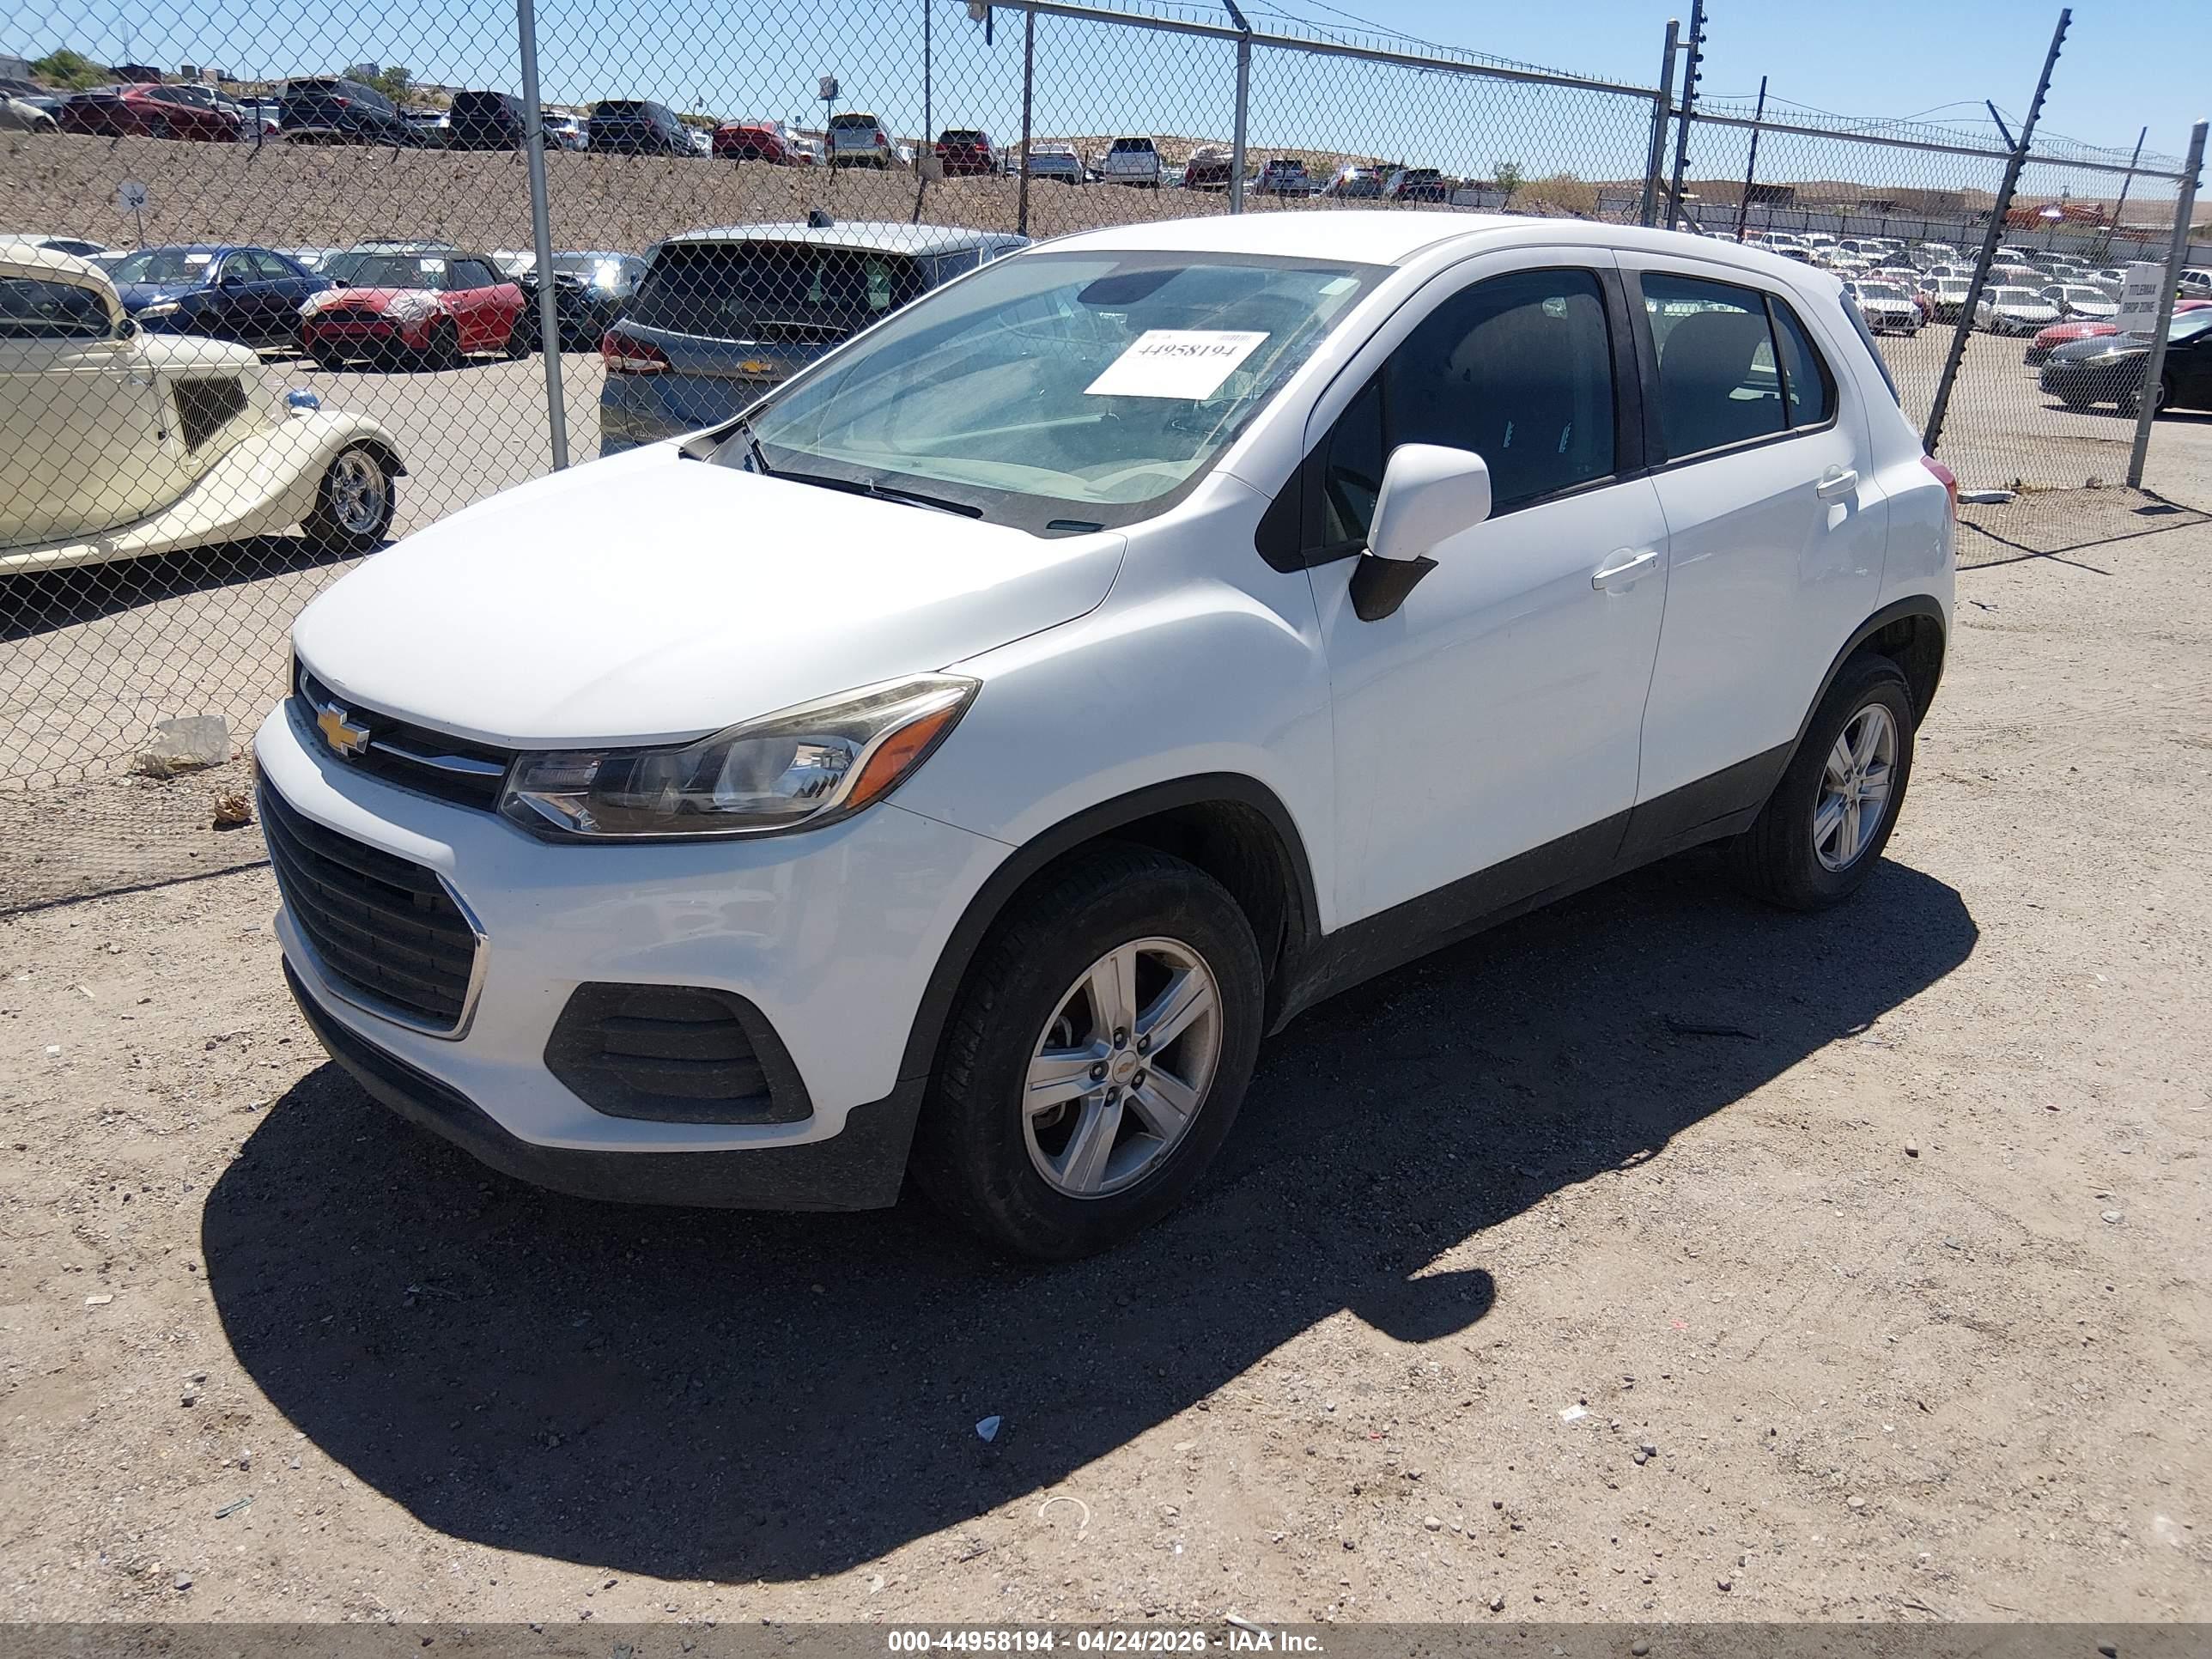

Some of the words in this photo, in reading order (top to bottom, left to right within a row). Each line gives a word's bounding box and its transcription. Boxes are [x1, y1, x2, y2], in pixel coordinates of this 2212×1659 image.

[2129, 284, 2156, 296] TITLEMAX
[2123, 301, 2139, 313] DROP
[2139, 301, 2155, 313] ZONE
[1139, 344, 1237, 356] 44958194
